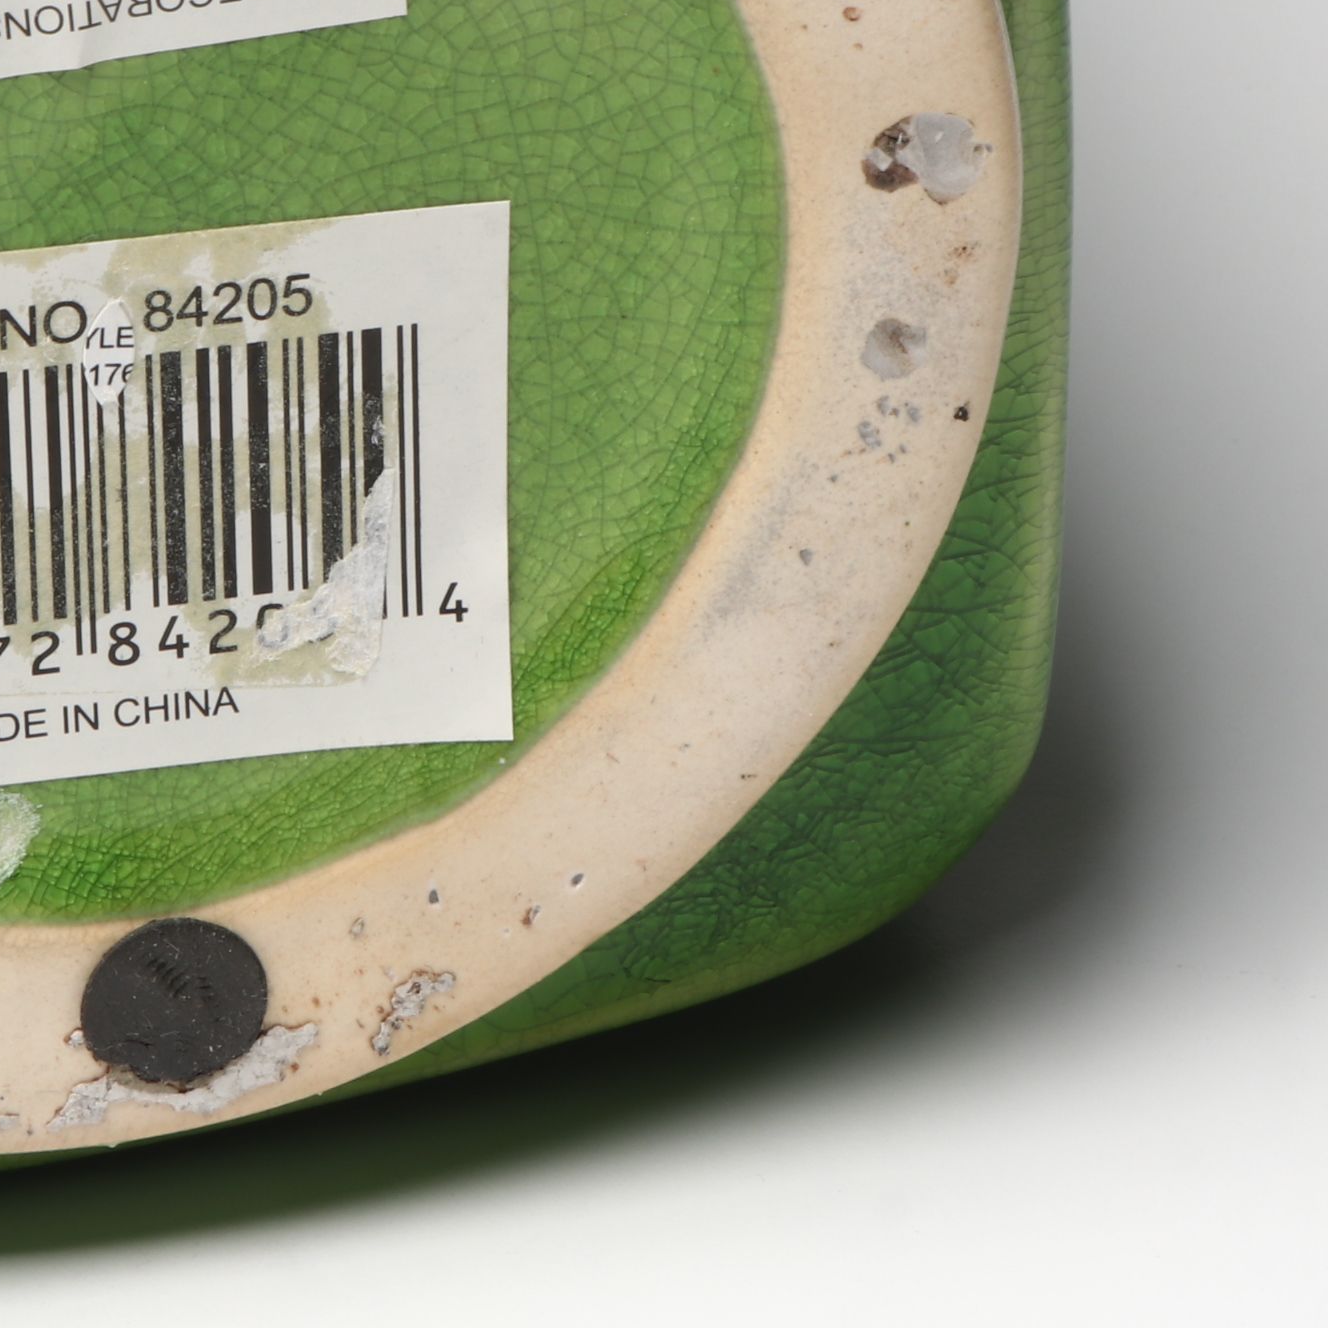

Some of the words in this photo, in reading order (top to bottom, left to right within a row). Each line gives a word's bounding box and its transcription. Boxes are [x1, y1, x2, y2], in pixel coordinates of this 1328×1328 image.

[143, 273, 314, 334] 84205
[438, 581, 469, 623] 4
[62, 702, 99, 735] IN
[113, 686, 240, 726] CHINA
